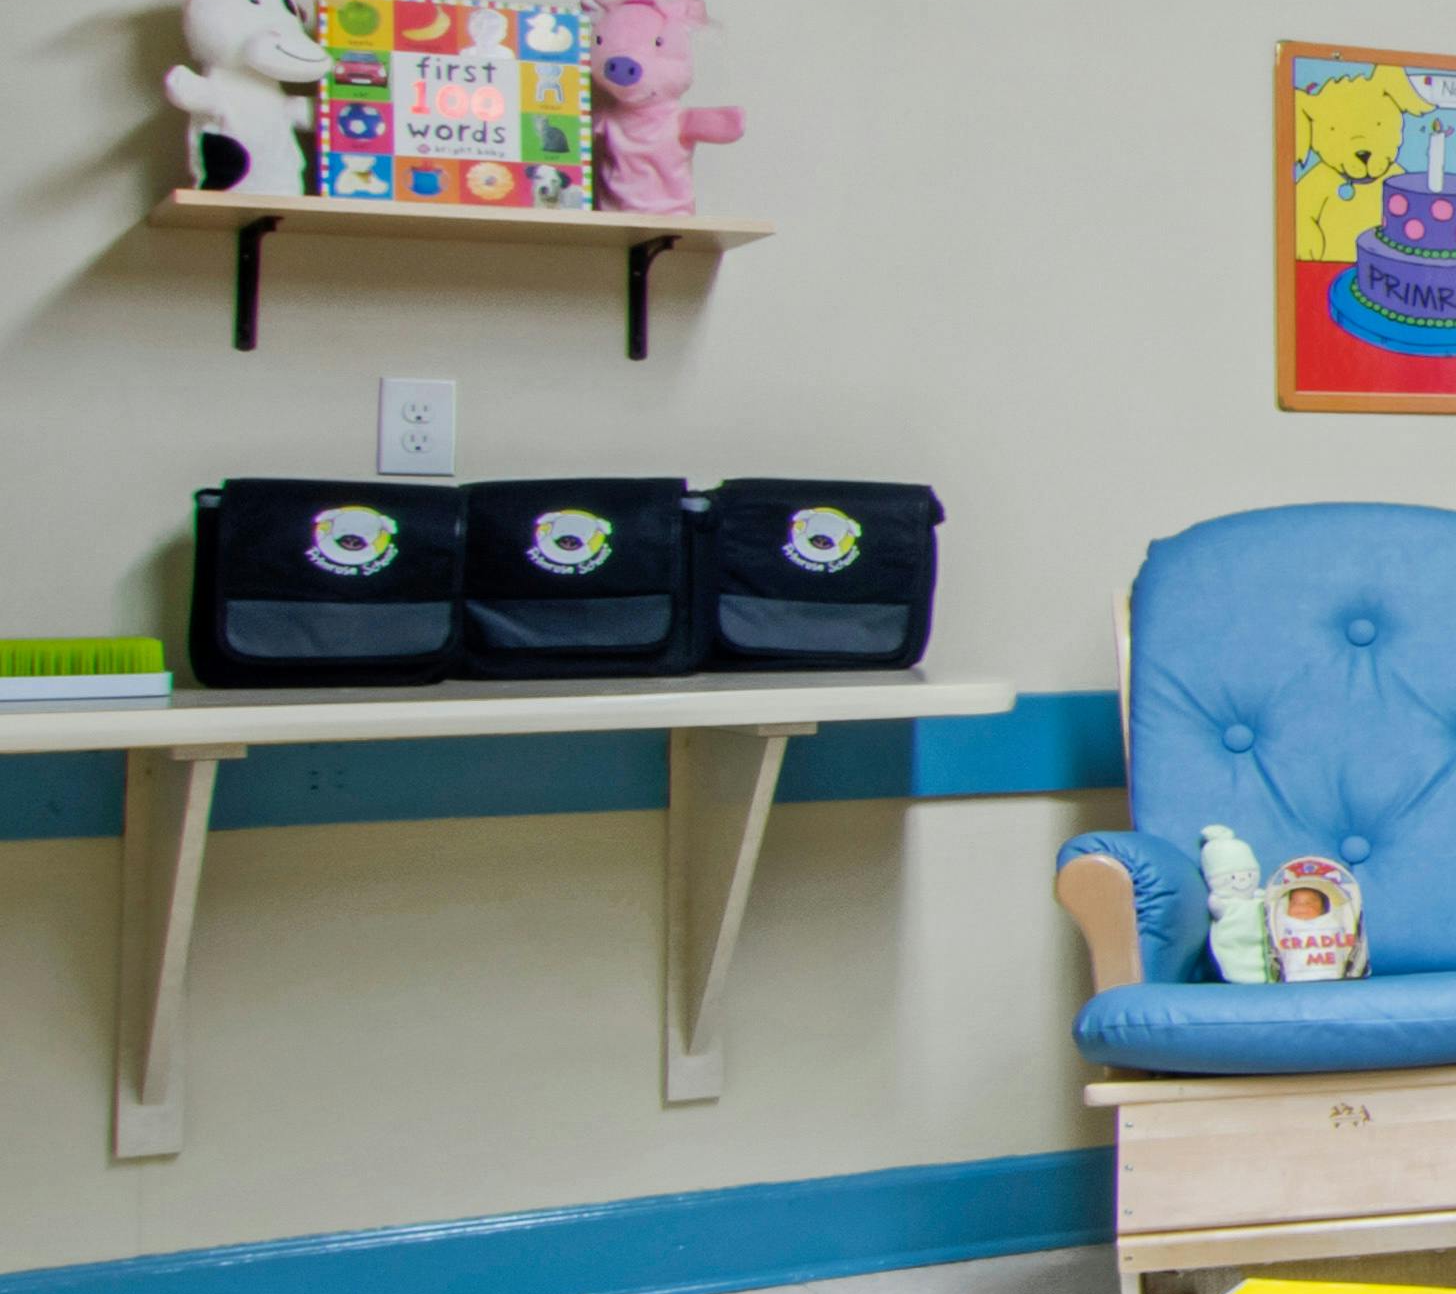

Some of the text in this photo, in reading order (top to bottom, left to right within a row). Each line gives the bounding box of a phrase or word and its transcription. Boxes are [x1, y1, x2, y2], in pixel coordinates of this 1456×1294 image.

[416, 56, 498, 83] first
[410, 81, 506, 122] 100
[407, 121, 507, 144] words
[1279, 932, 1357, 950] CRADLE
[1306, 951, 1336, 966] ME
